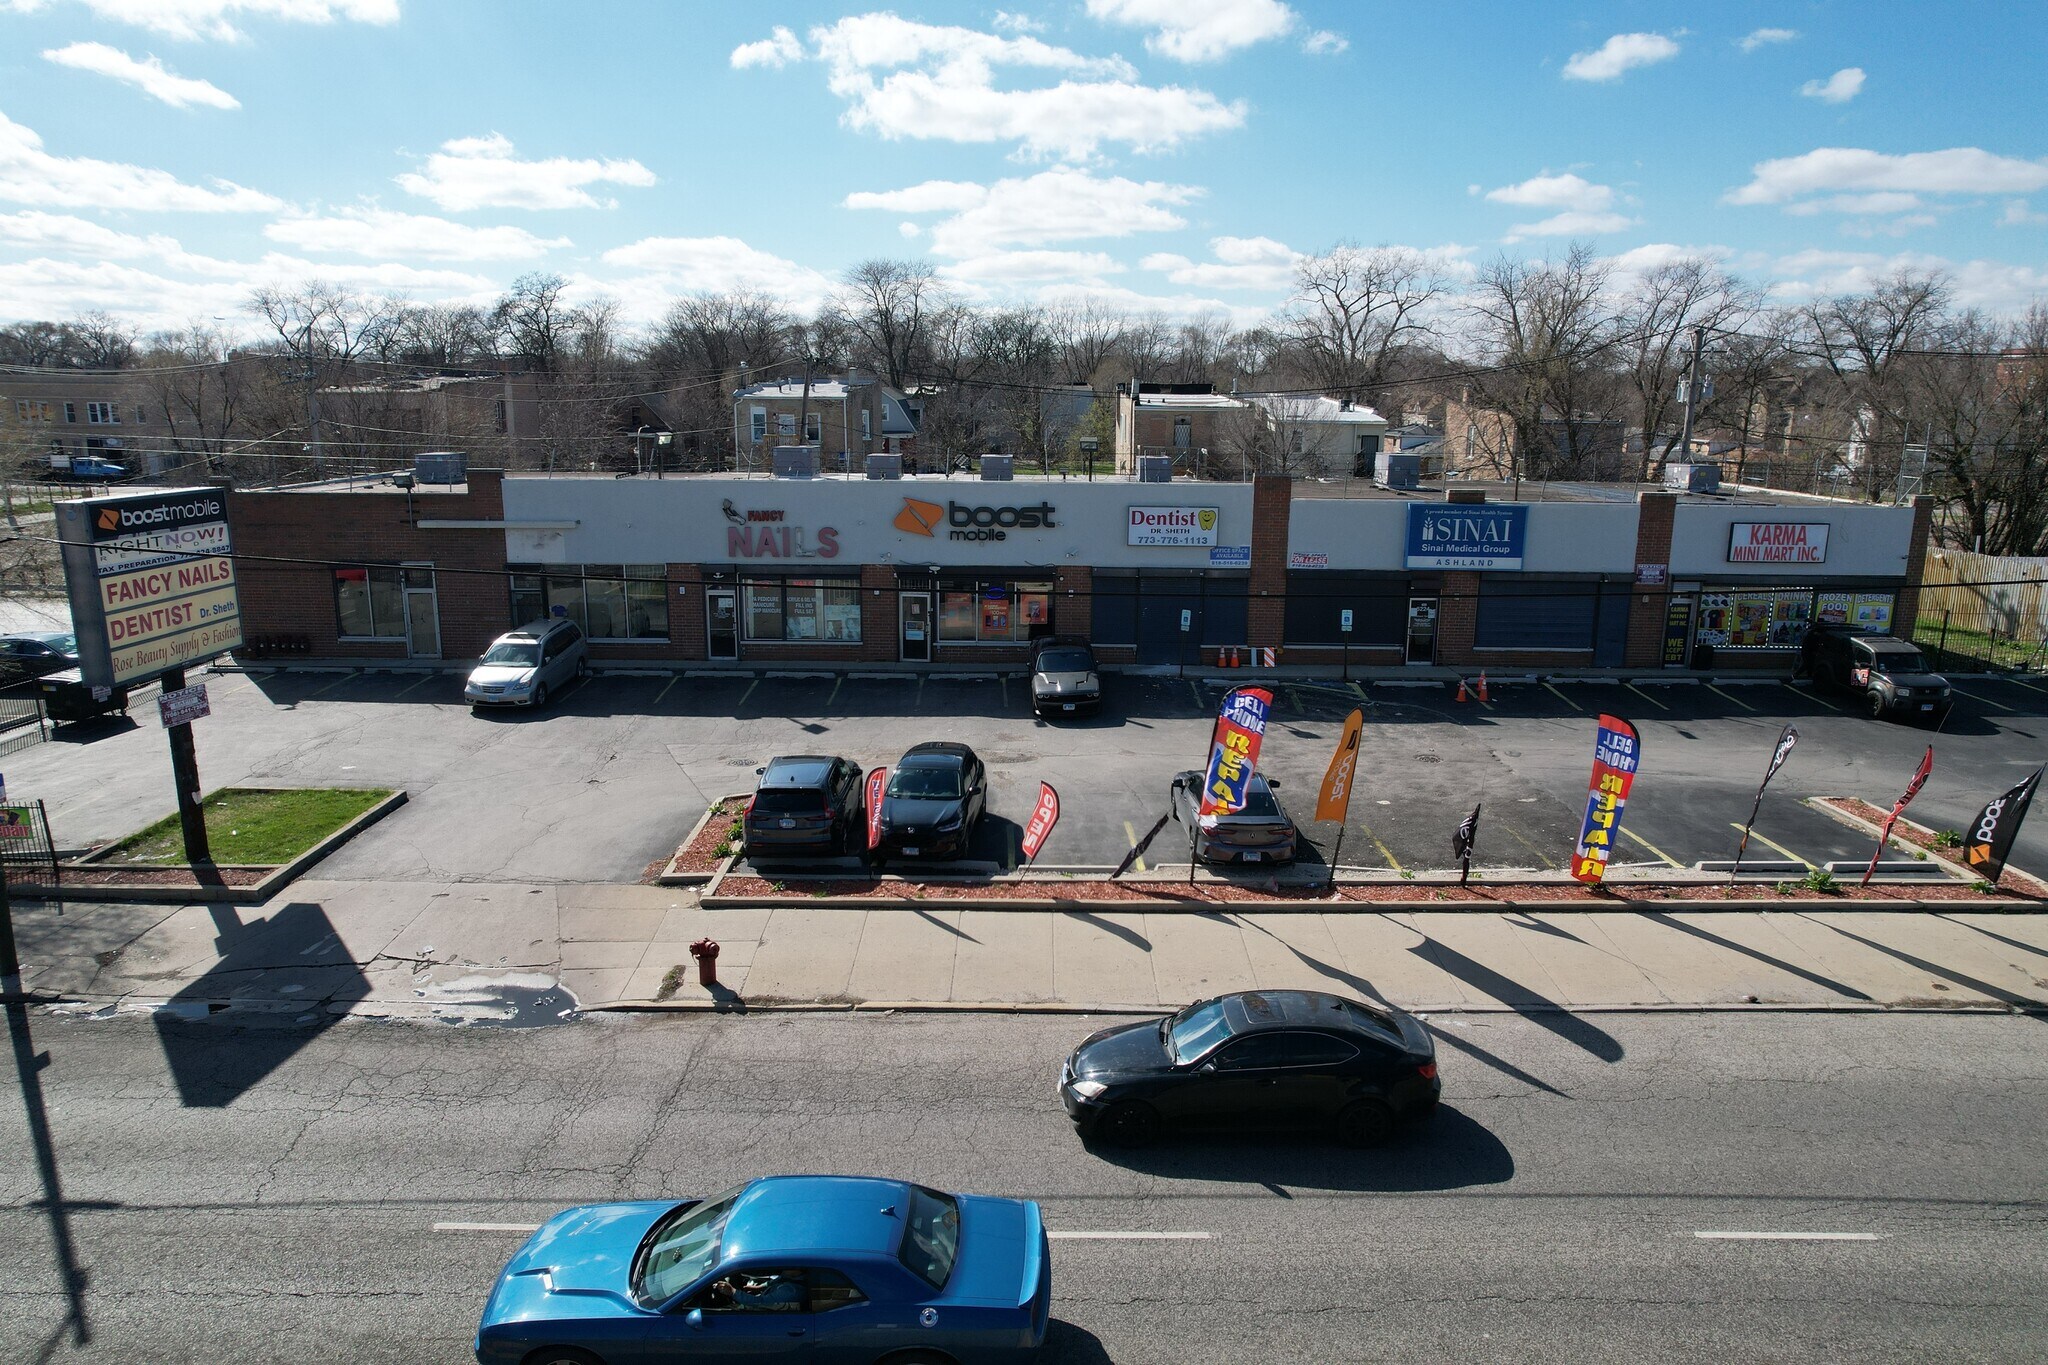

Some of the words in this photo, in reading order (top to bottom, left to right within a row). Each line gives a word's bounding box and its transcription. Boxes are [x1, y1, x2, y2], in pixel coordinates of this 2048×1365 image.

[747, 510, 785, 521] FANCY
[949, 501, 1055, 528] boost
[1131, 510, 1196, 526] Dentist
[950, 528, 1006, 541] mobile
[1436, 518, 1512, 542] SINAI
[1750, 525, 1807, 545] KARMA
[728, 526, 839, 558] NAILS
[1138, 536, 1208, 544] 773-776-1113
[1421, 543, 1444, 552] Sinai
[1446, 544, 1480, 552] Medical
[1482, 545, 1510, 554] Group
[1733, 546, 1760, 560] MINI
[1763, 546, 1794, 560] MART
[1797, 546, 1820, 561] INC.
[98, 565, 115, 573] TAX
[118, 555, 176, 569] PREPARATION
[106, 572, 172, 604] FANCY
[178, 561, 230, 589] NAILS
[1778, 592, 1812, 601] DRINKS
[1817, 593, 1853, 602] FROZEN
[1857, 594, 1895, 604] DETERGENTS
[1821, 603, 1849, 612] FOOD
[110, 602, 193, 641] DENTIST
[200, 608, 211, 618] Dr.
[212, 601, 235, 615] Sheth
[113, 657, 133, 673] Rose
[136, 648, 169, 666] Beauty
[170, 632, 200, 659] Supply
[213, 623, 240, 644] Fashion
[1667, 638, 1684, 647] WE
[159, 685, 205, 702] NOTICE
[1224, 707, 1266, 735] PHONE
